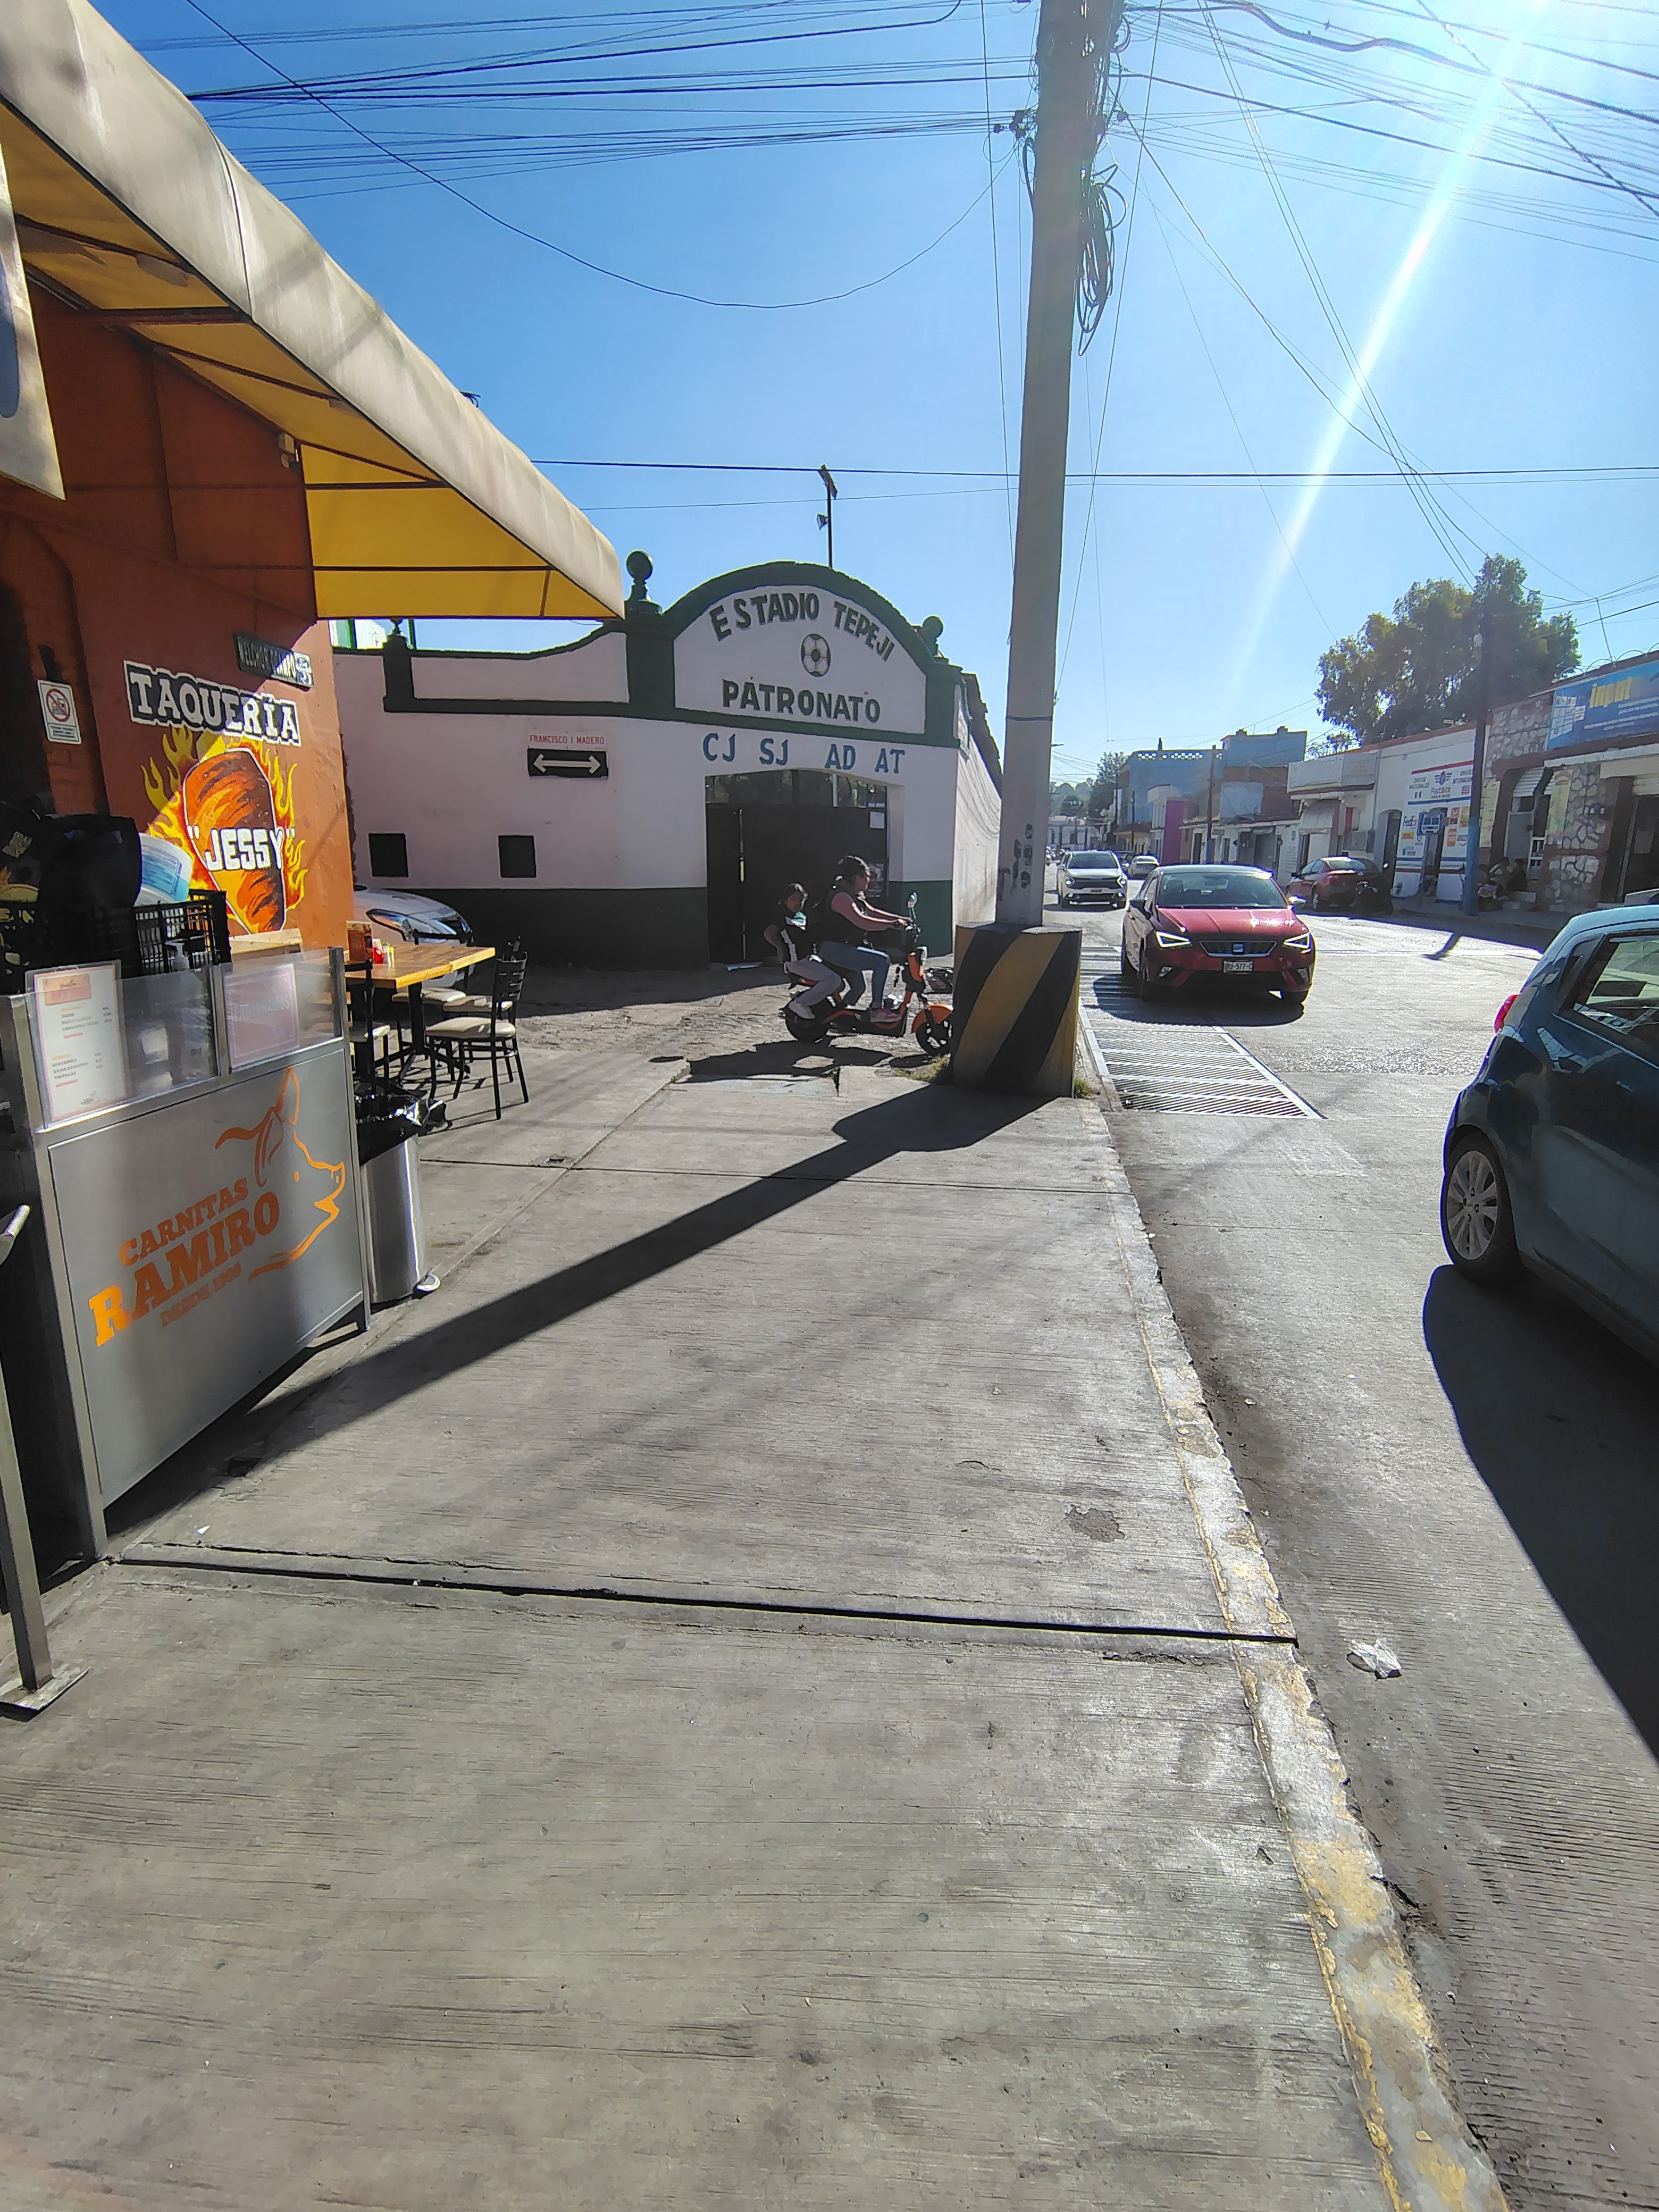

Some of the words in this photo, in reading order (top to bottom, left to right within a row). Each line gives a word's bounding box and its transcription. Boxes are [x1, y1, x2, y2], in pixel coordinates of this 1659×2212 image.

[709, 592, 819, 641] ESTADIO
[833, 600, 895, 662] TEPEJI
[130, 672, 299, 740] TAQUERÍA
[722, 678, 881, 723] PATRONATO
[530, 734, 567, 744] FRANCISCO
[576, 735, 605, 745] MADERO
[702, 732, 736, 763] CJ
[759, 738, 789, 766] SJ
[824, 743, 856, 770] AD
[874, 748, 905, 774] AT
[119, 1177, 249, 1266] CARNITAS
[88, 1192, 279, 1347] RAMIRO
